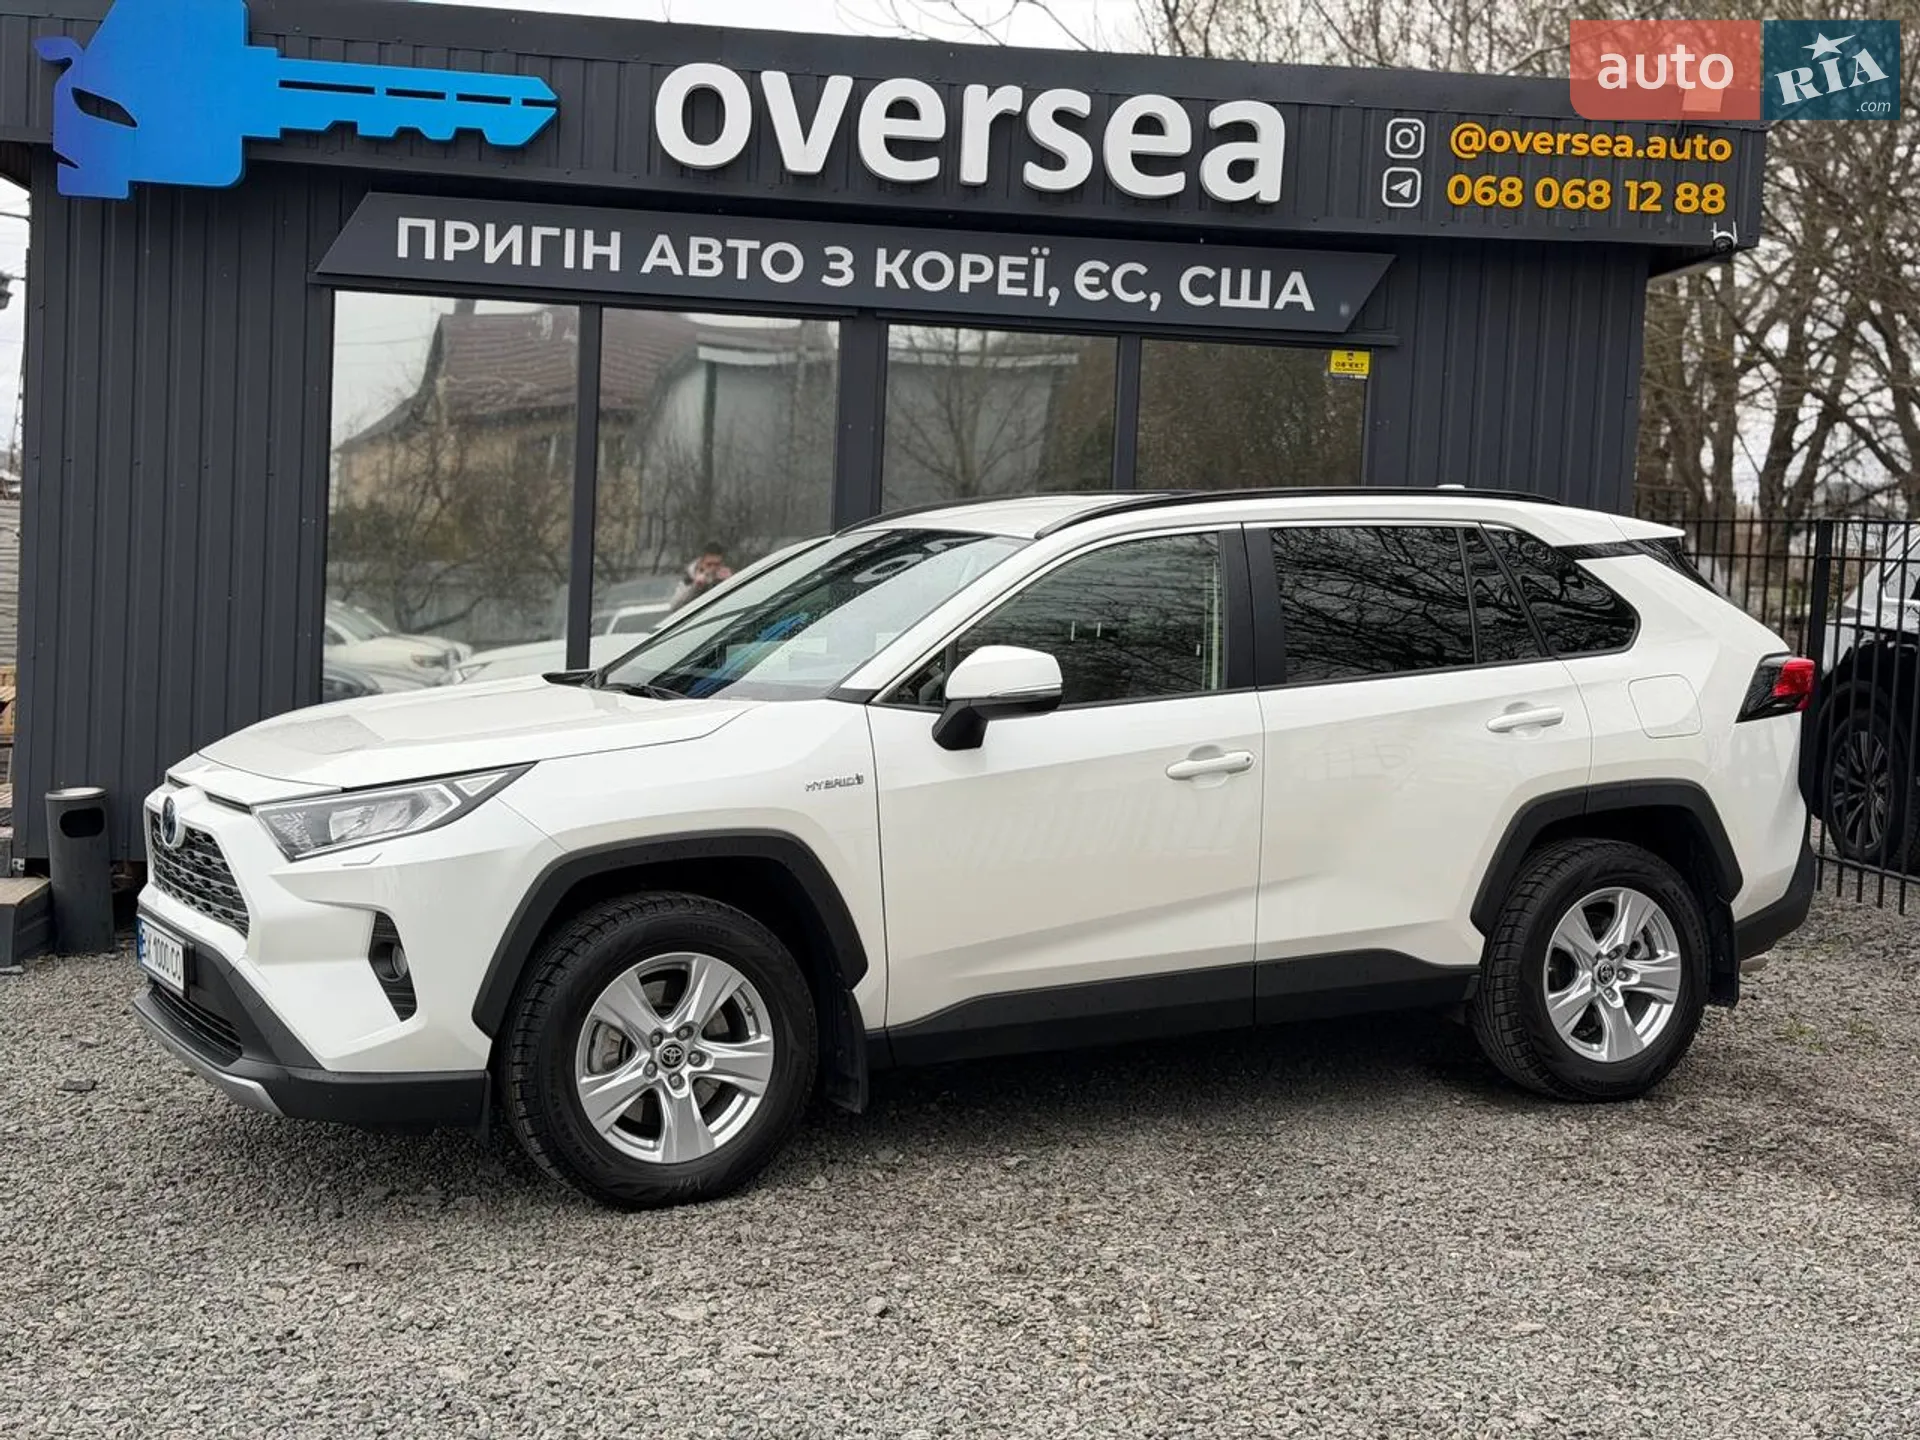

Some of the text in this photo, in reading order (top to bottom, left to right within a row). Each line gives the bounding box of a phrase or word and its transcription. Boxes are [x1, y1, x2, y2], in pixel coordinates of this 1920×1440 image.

[655, 62, 1286, 204] oversea
[1450, 122, 1733, 162] @oversea.auto
[1446, 173, 1727, 215] 068 068 12 88
[397, 216, 1316, 313] ПРИГІН АВТО З КОРЕЇ, ЄС, США
[804, 776, 856, 792] HYBRID
